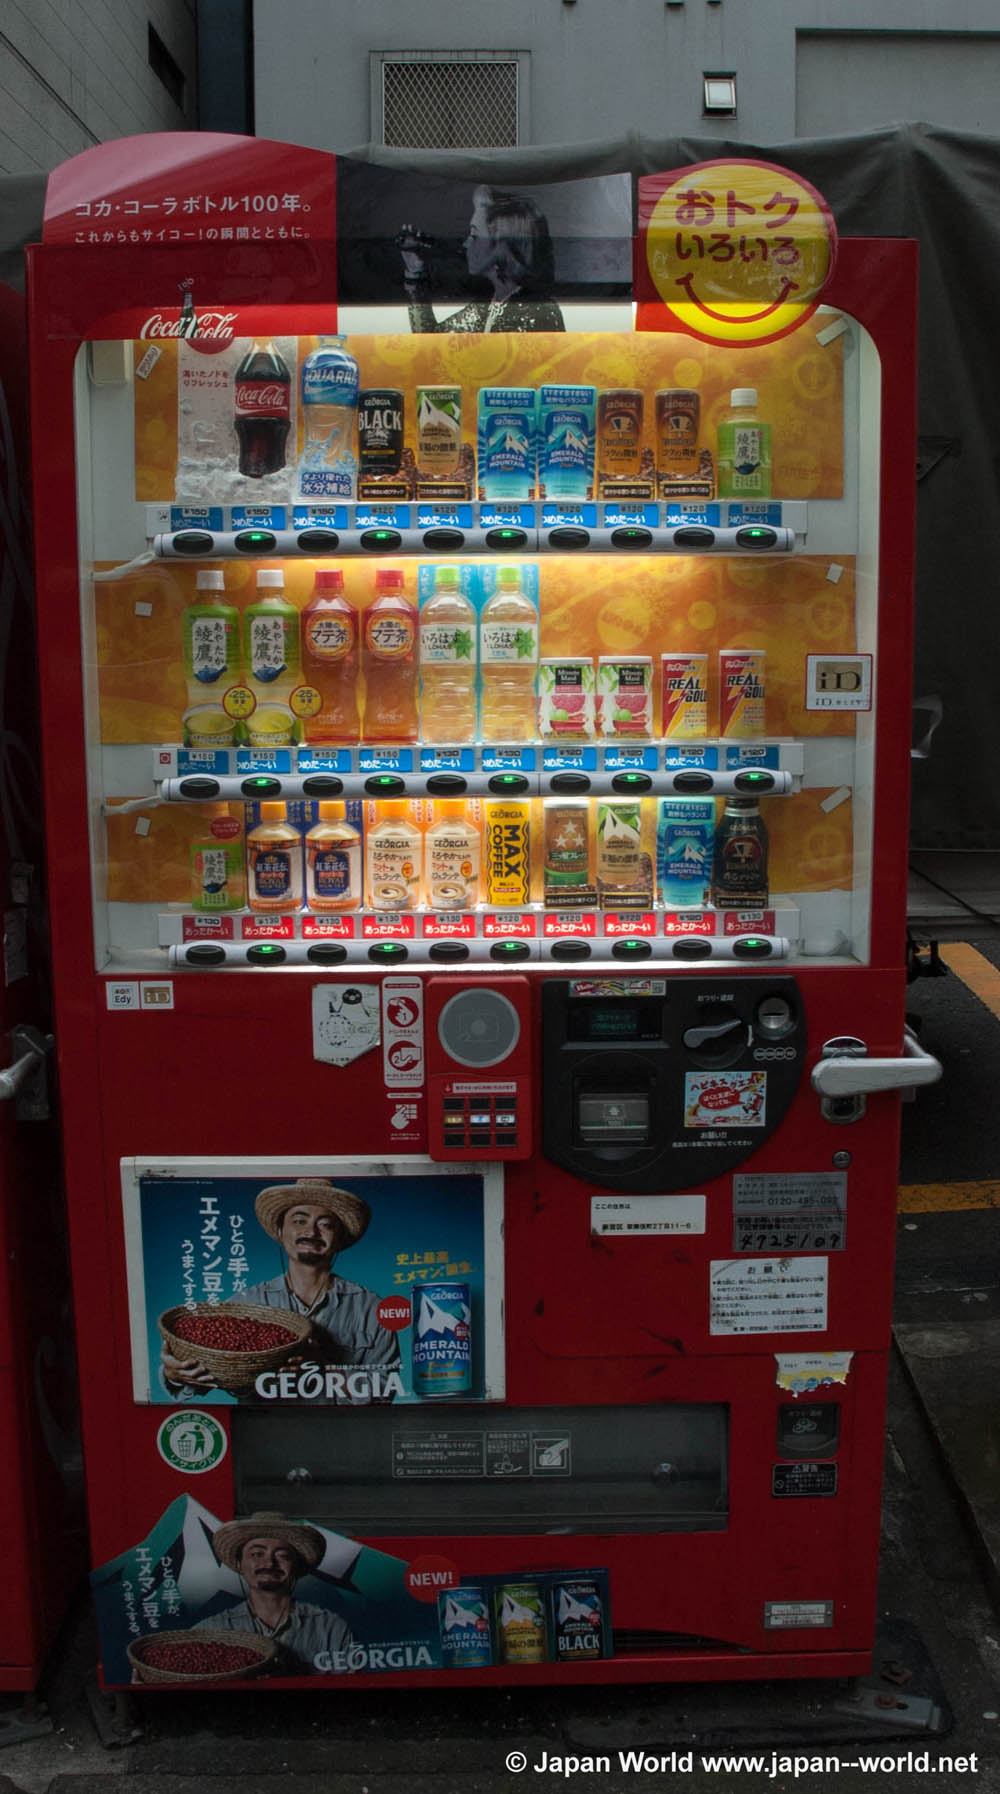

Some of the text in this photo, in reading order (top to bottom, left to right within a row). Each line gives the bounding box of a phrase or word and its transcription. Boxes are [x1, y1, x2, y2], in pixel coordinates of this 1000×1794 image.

[75, 194, 312, 217] コカ・コーラボトル100年。
[675, 190, 800, 228] おトク
[675, 232, 800, 265] いろいろ
[236, 385, 286, 406] Coca-Cola
[358, 409, 402, 431] BLACK
[194, 624, 215, 661] 綾鷹
[213, 621, 225, 666] あやたか
[254, 623, 273, 661] 綾鷹
[273, 620, 284, 666] あやたか
[309, 629, 349, 644] マテ茶
[370, 628, 409, 644] マテ茶
[421, 630, 460, 644] いろはす
[483, 629, 521, 643] いろはす
[668, 676, 701, 689] REAL
[727, 672, 760, 686] REAL
[820, 671, 862, 690] iD
[375, 839, 410, 849] GEORGIA
[433, 838, 468, 848] GEORGIA
[493, 824, 503, 878] COFFEE
[504, 824, 521, 878] MAX
[115, 995, 131, 1005] Edy
[394, 1055, 400, 1064] 2
[199, 1197, 224, 1307] エメマン豆を
[227, 1215, 249, 1296] ひとの手が、
[181, 1239, 199, 1316] うまくする。
[430, 1290, 464, 1300] GEORGIA
[379, 1308, 410, 1318] NEW!
[415, 1340, 469, 1352] EMERALD
[255, 1361, 406, 1399] GEORGIA
[409, 1571, 453, 1586] NEW!
[558, 1634, 600, 1650] BLACK
[313, 1642, 433, 1673] GEORGIA
